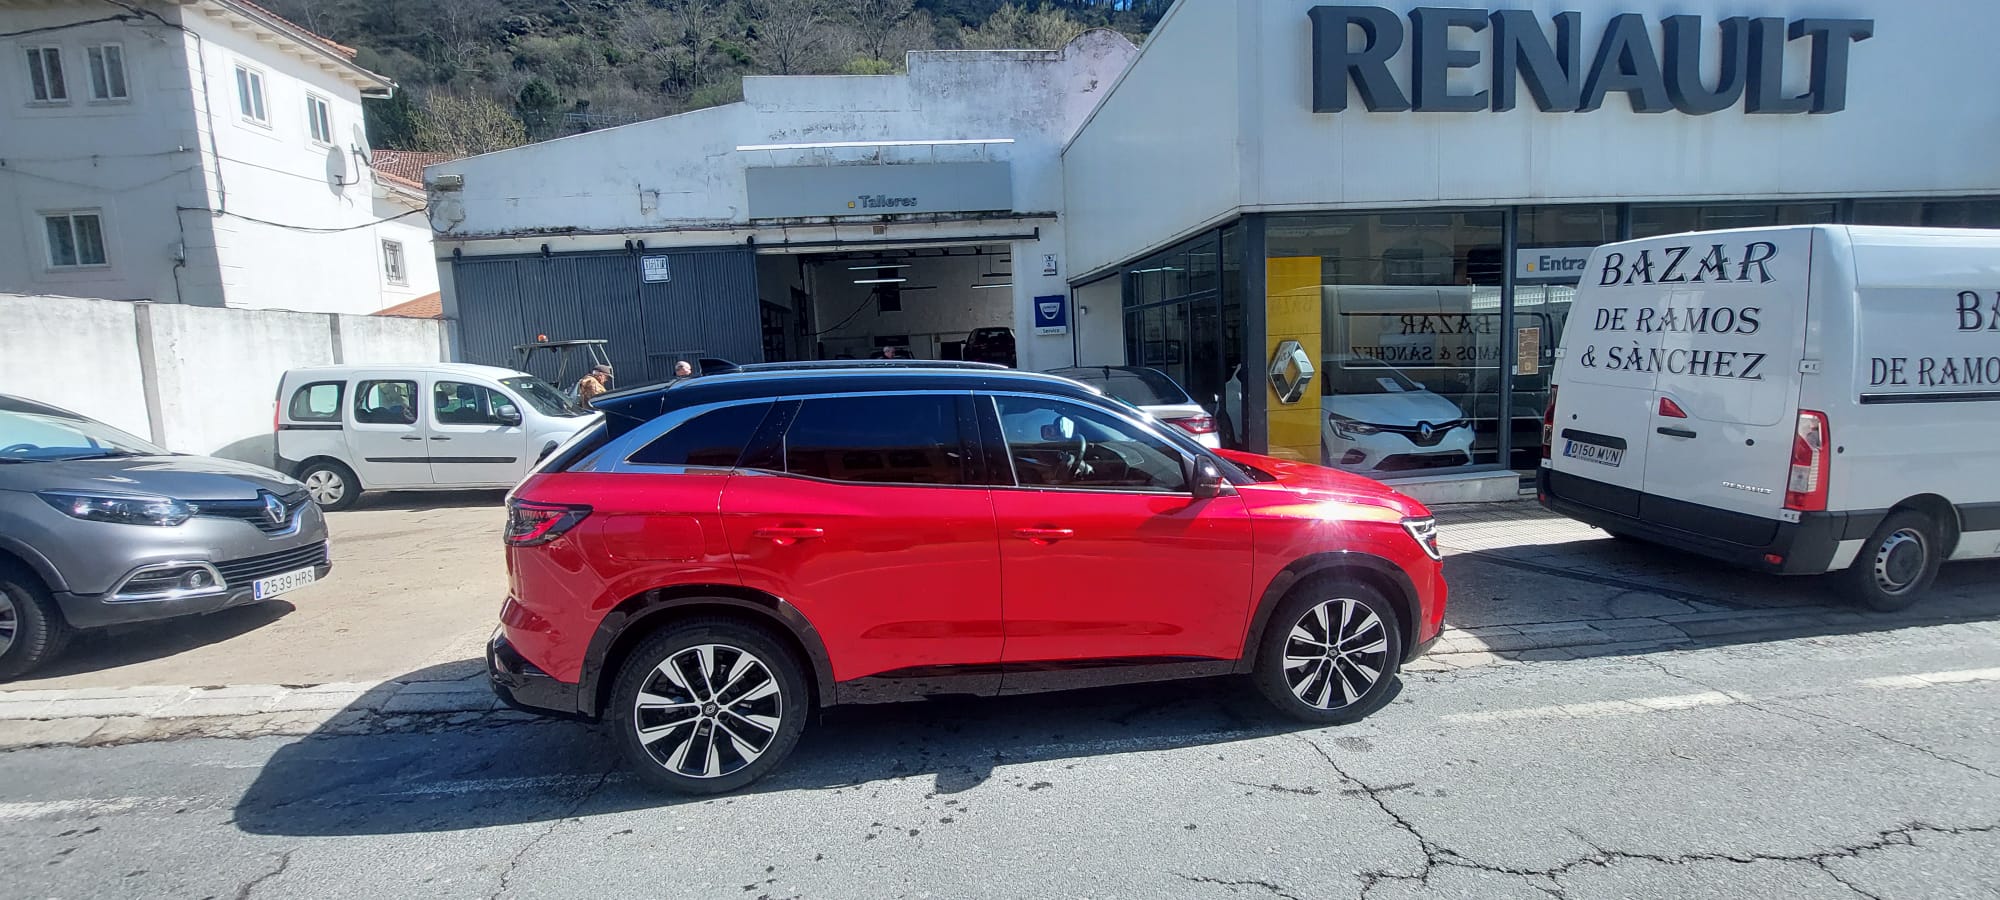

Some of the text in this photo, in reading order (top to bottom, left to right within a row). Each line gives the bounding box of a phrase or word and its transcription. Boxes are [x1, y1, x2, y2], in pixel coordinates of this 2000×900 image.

[1307, 5, 1875, 116] RENAULT
[858, 194, 918, 208] Talleres
[1598, 241, 1778, 286] BAZAR
[1594, 306, 1762, 335] DE RAMOS
[1581, 344, 1597, 369] &
[1870, 356, 2000, 387] DE RAMO
[1571, 443, 1595, 457] 0150
[1597, 447, 1619, 462] MVN
[263, 570, 313, 595] 2539 HRS
